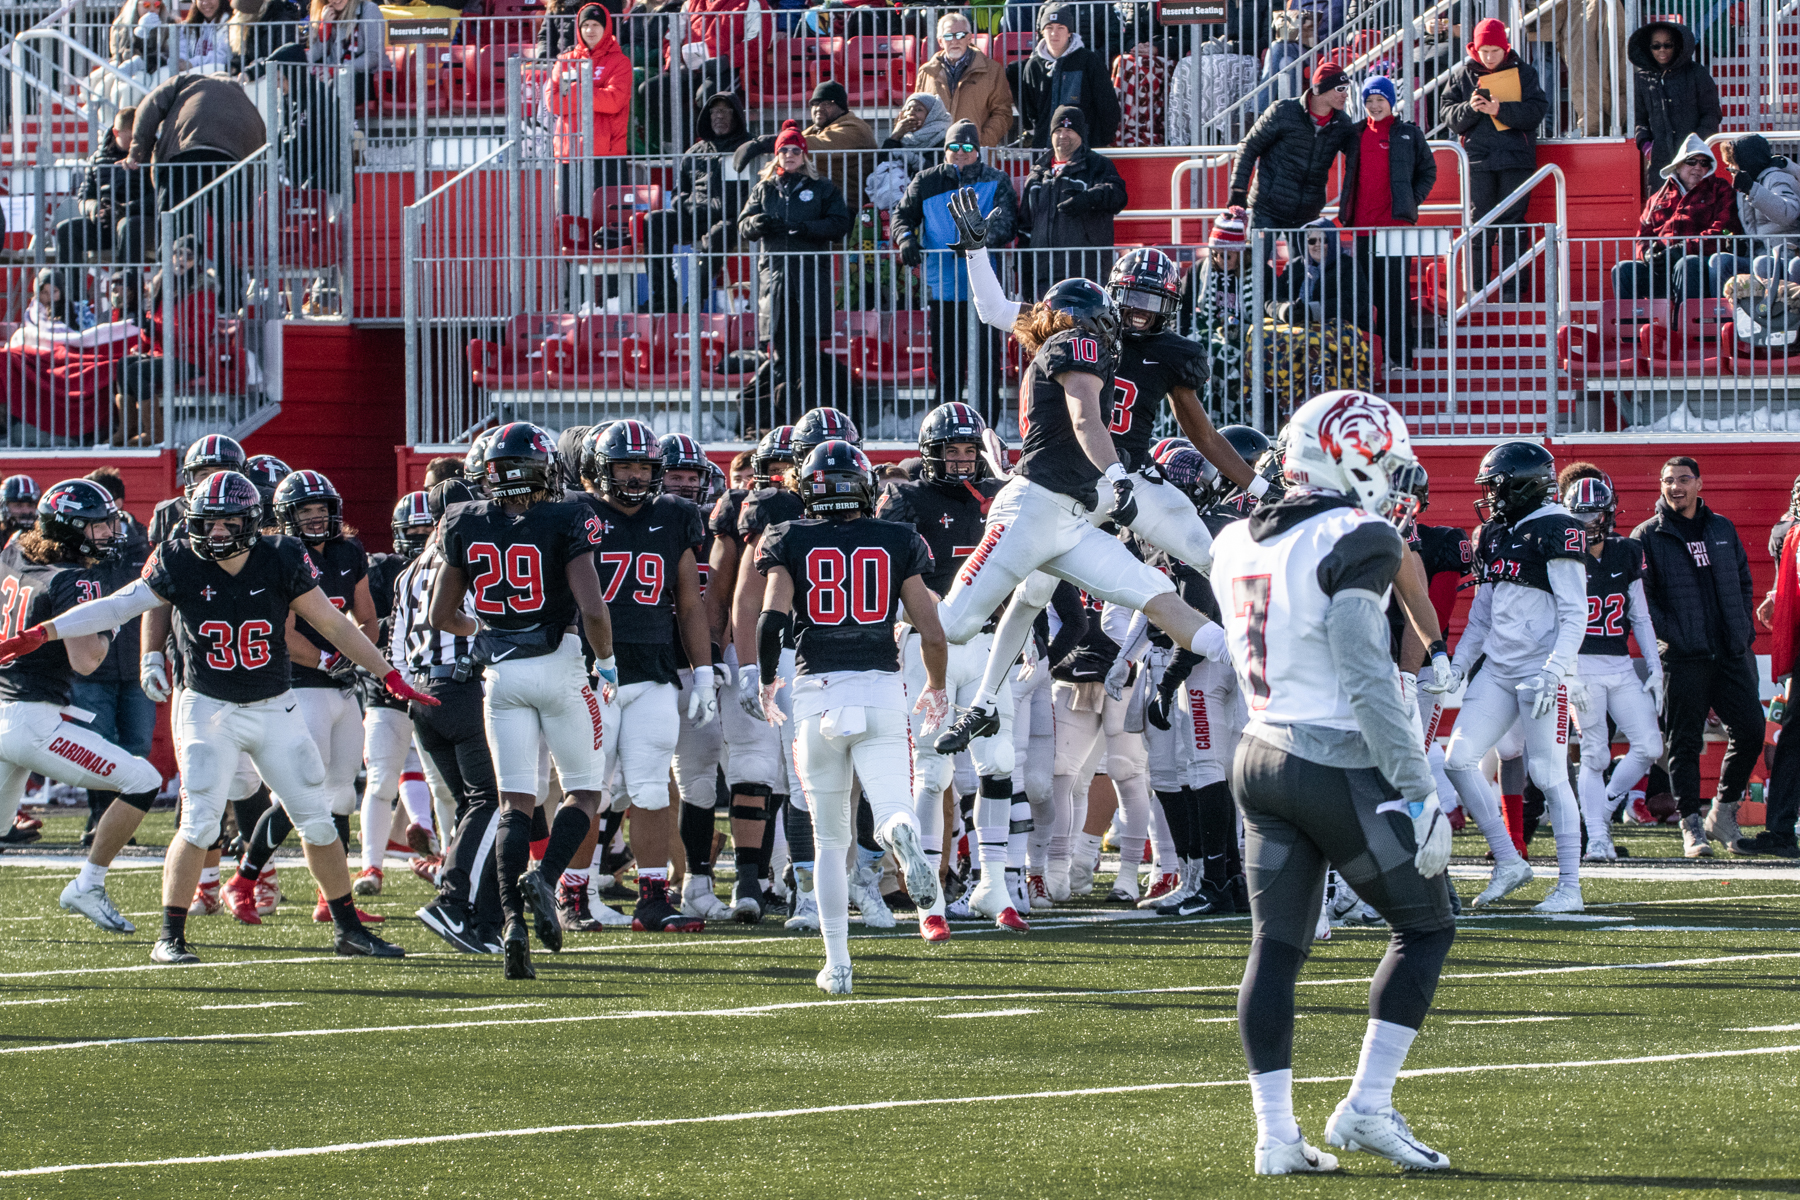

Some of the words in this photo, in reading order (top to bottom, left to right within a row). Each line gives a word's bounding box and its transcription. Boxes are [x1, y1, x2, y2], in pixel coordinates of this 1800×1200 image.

[389, 26, 420, 36] Reserved
[421, 26, 449, 36] Seating
[1161, 6, 1194, 16] Reserved
[1195, 5, 1224, 16] Seating
[1067, 337, 1098, 363] 10
[507, 486, 532, 496] BIRDS
[812, 503, 834, 512] DIRTY
[835, 501, 859, 510] BIRDS
[960, 523, 1006, 587] CARDINALS
[1564, 527, 1587, 554] 21
[75, 579, 102, 604] 31
[466, 541, 546, 615] 29
[600, 551, 665, 606] 79
[805, 546, 891, 626] 80
[0, 574, 34, 641] 31
[1585, 592, 1626, 637] 22
[198, 618, 273, 671] 36
[1231, 573, 1272, 711] 7
[580, 684, 604, 751] CARDINALS
[1189, 688, 1211, 750] CARDINALS
[1555, 684, 1568, 745] CARDINALS
[48, 736, 117, 777] CARDINALS
